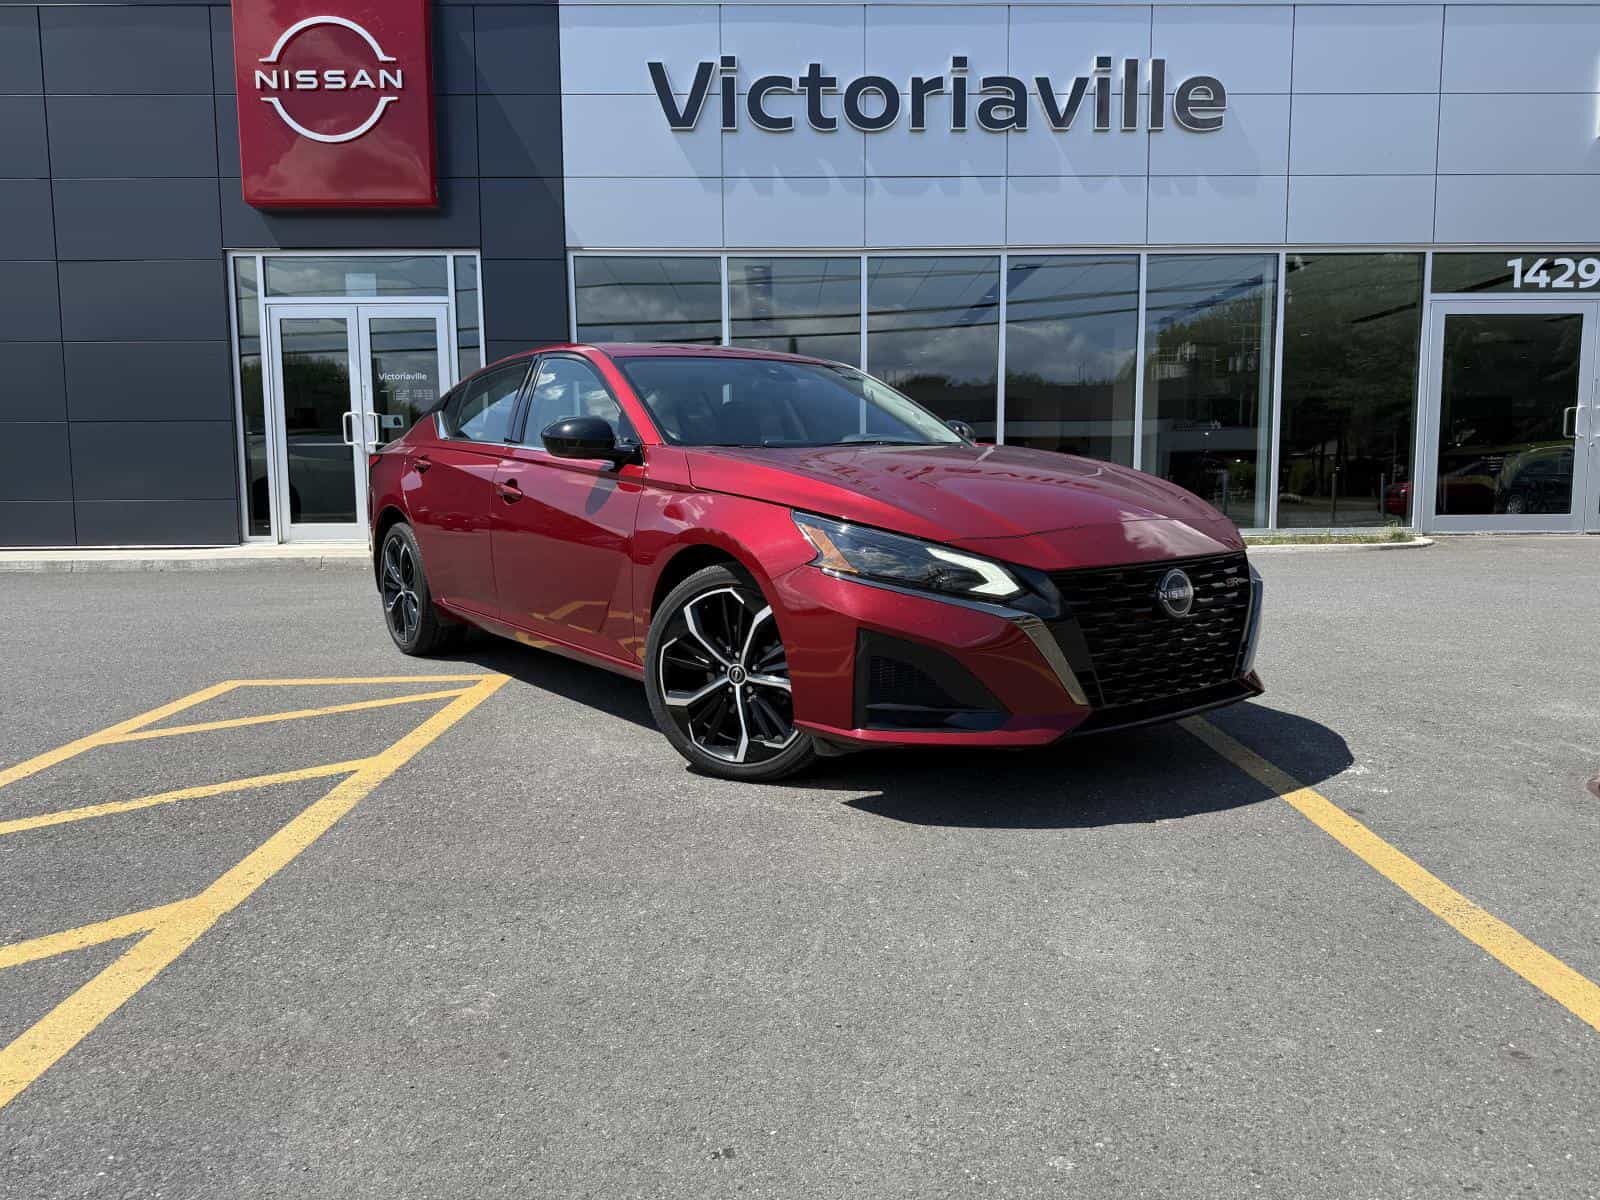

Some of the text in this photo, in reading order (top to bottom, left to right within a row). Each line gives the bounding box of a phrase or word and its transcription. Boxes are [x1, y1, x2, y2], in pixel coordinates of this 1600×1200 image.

[254, 69, 403, 90] NISSAN
[647, 54, 1227, 133] Victoriaville
[1506, 257, 1600, 289] 1429
[378, 371, 427, 381] Victoriaville
